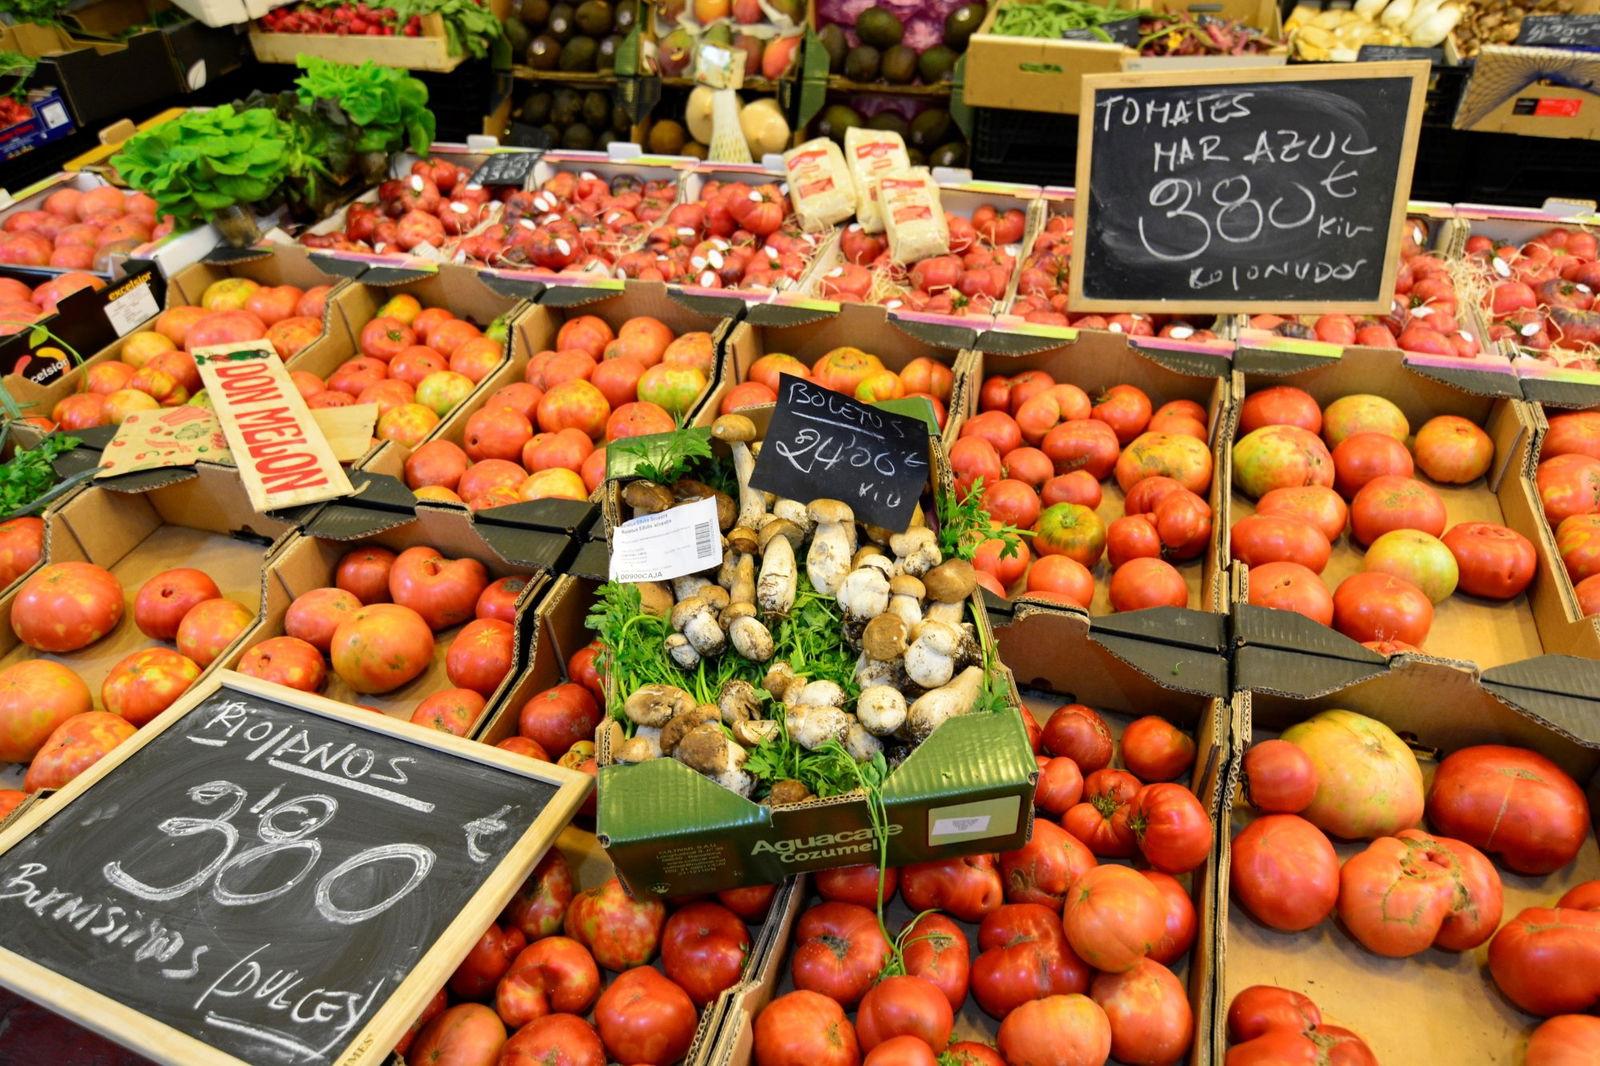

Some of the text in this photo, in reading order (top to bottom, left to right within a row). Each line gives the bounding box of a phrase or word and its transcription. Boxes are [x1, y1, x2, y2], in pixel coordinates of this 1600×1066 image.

[1096, 92, 1255, 132] TOMATES
[1153, 130, 1378, 172] MAR AZUL
[108, 271, 152, 301] excelsior
[215, 362, 329, 495] DON MELON
